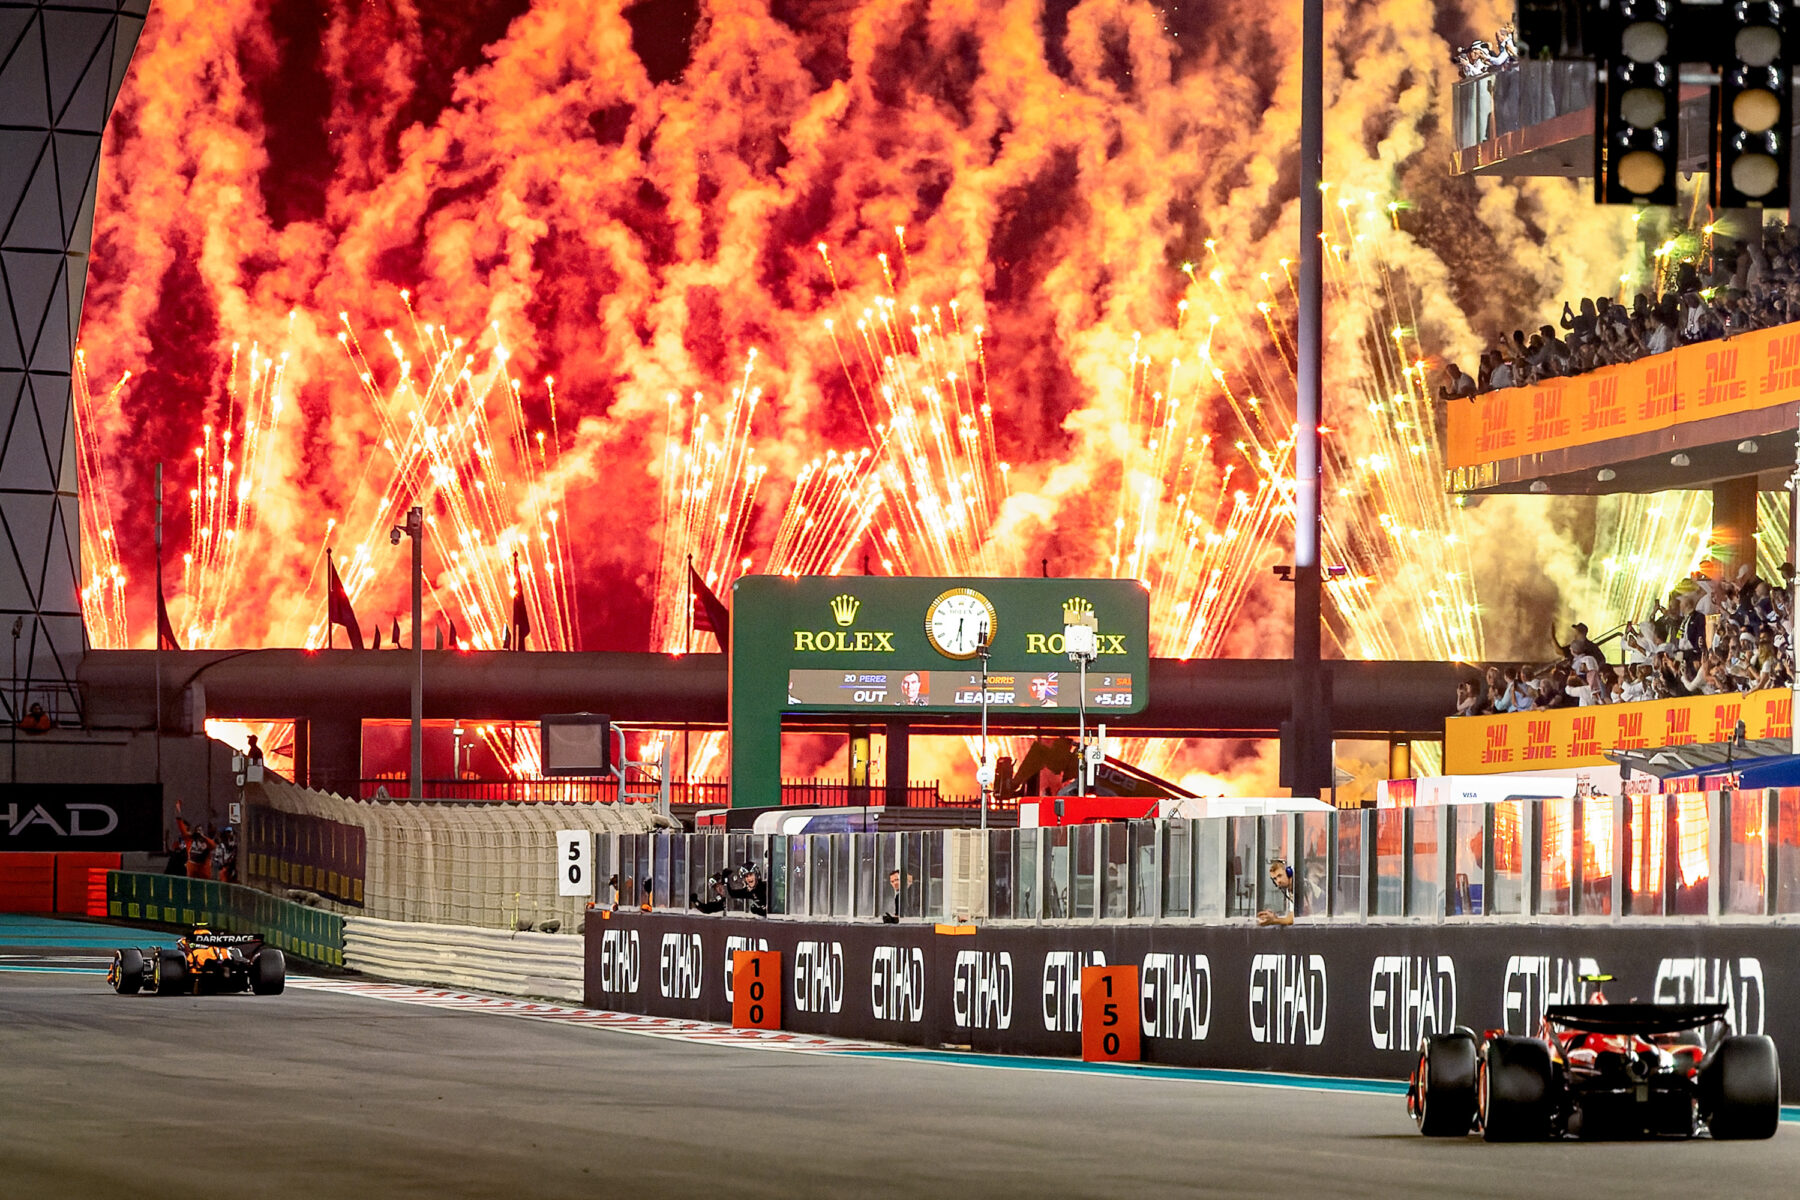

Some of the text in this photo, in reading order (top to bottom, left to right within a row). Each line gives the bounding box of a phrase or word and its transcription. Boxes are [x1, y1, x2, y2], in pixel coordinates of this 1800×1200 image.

[1698, 347, 1746, 406] DHL
[794, 631, 895, 652] ROLEX
[1026, 633, 1128, 655] ROEX
[844, 674, 887, 683] 20 PEREZ
[853, 690, 887, 702] OUT
[954, 691, 1016, 704] LEADER
[970, 676, 976, 684] 1
[1095, 693, 1132, 705] +5.83
[1104, 677, 1111, 686] 2
[1481, 724, 1513, 764] DHL
[1523, 720, 1556, 760] DHL
[1567, 716, 1602, 758] DHL
[568, 841, 581, 884] 50
[195, 935, 255, 943] DARKTRACE
[601, 929, 641, 993] ETIHAD
[660, 933, 703, 999] ETIHAD
[794, 941, 844, 1013] ETIHAD
[750, 958, 764, 1024] 100
[871, 946, 925, 1022] ETIHAD
[953, 950, 1013, 1030] ETIHAD
[1042, 951, 1107, 1032] ETIH
[1141, 953, 1212, 1040] ETIHAD
[1249, 954, 1328, 1046] ETIHAD
[1370, 956, 1456, 1051] ETIHAD
[1101, 975, 1120, 1056] 150
